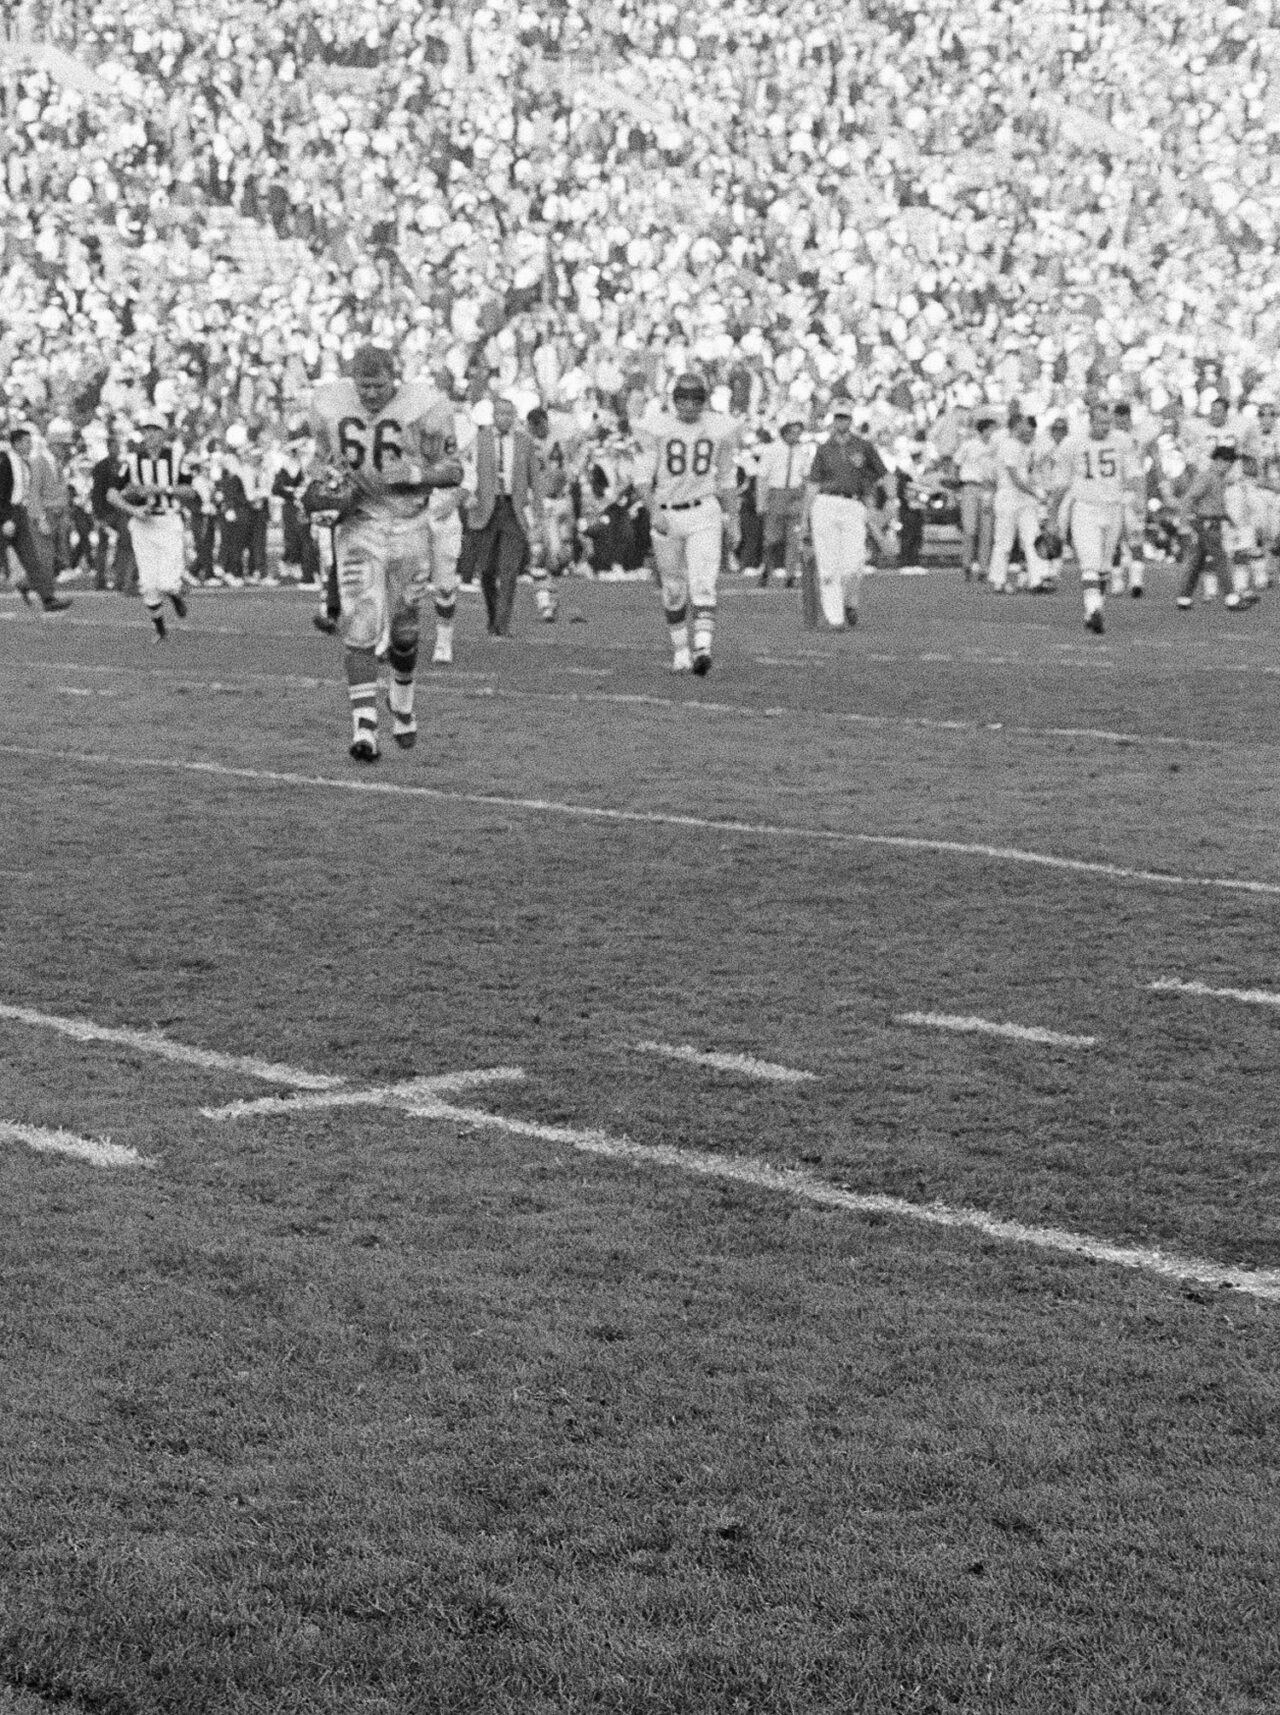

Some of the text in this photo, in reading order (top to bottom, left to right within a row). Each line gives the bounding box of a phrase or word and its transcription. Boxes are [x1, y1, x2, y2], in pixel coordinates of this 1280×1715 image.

[338, 416, 402, 472] 66
[666, 438, 714, 477] 88
[1083, 448, 1116, 480] 15
